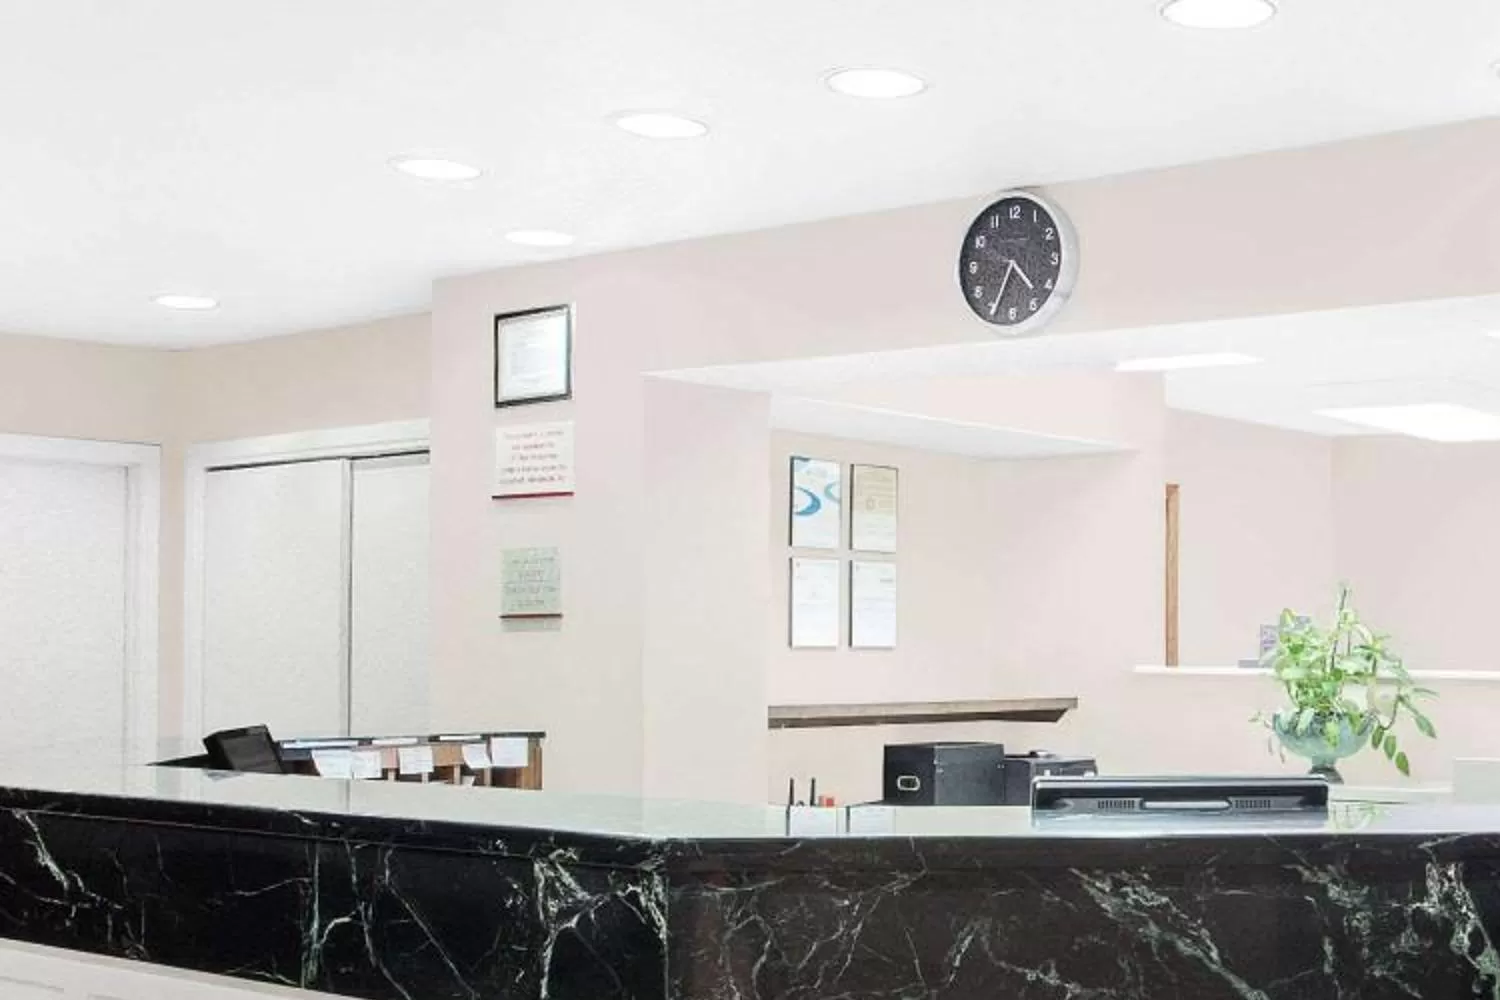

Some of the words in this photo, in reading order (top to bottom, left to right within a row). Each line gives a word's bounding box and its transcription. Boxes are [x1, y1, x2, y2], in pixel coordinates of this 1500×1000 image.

[1008, 204, 1021, 219] 12
[1032, 208, 1037, 223] 1
[990, 214, 999, 229] 11
[1044, 226, 1055, 241] 2
[975, 235, 985, 249] 10
[1050, 252, 1059, 265] 3
[968, 260, 978, 274] 9
[1043, 278, 1053, 290] 4
[973, 285, 984, 299] 8
[1028, 297, 1039, 311] 5
[1008, 306, 1018, 321] 6
